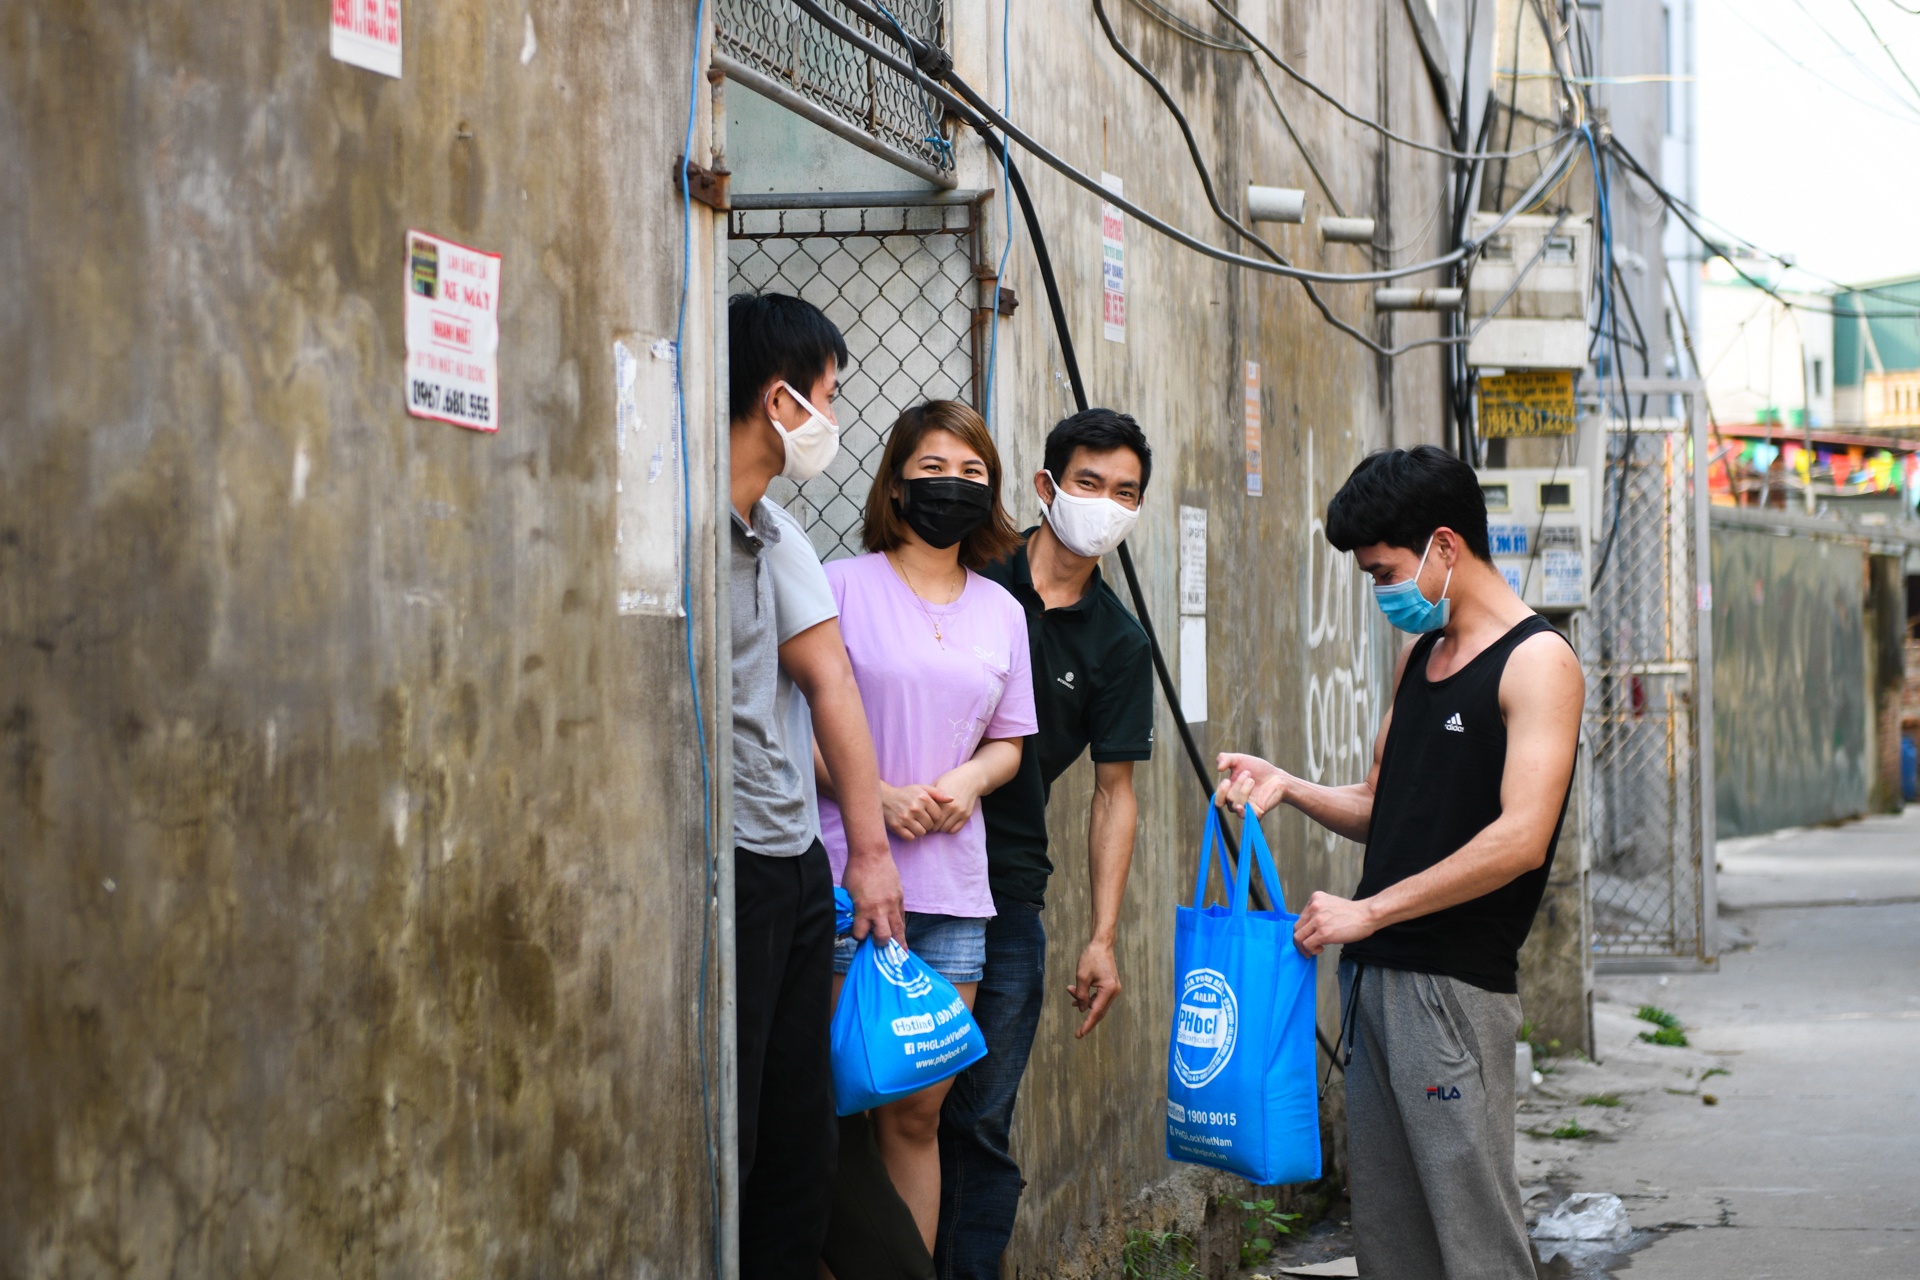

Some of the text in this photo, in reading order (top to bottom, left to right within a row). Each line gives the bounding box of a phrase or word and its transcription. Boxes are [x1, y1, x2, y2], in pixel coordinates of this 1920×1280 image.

[443, 279, 458, 302] XE
[413, 379, 491, 423] 0967.680.555
[894, 1018, 933, 1033] Hotline
[1187, 1109, 1208, 1125] 1900
[1209, 1111, 1237, 1127] 9015
